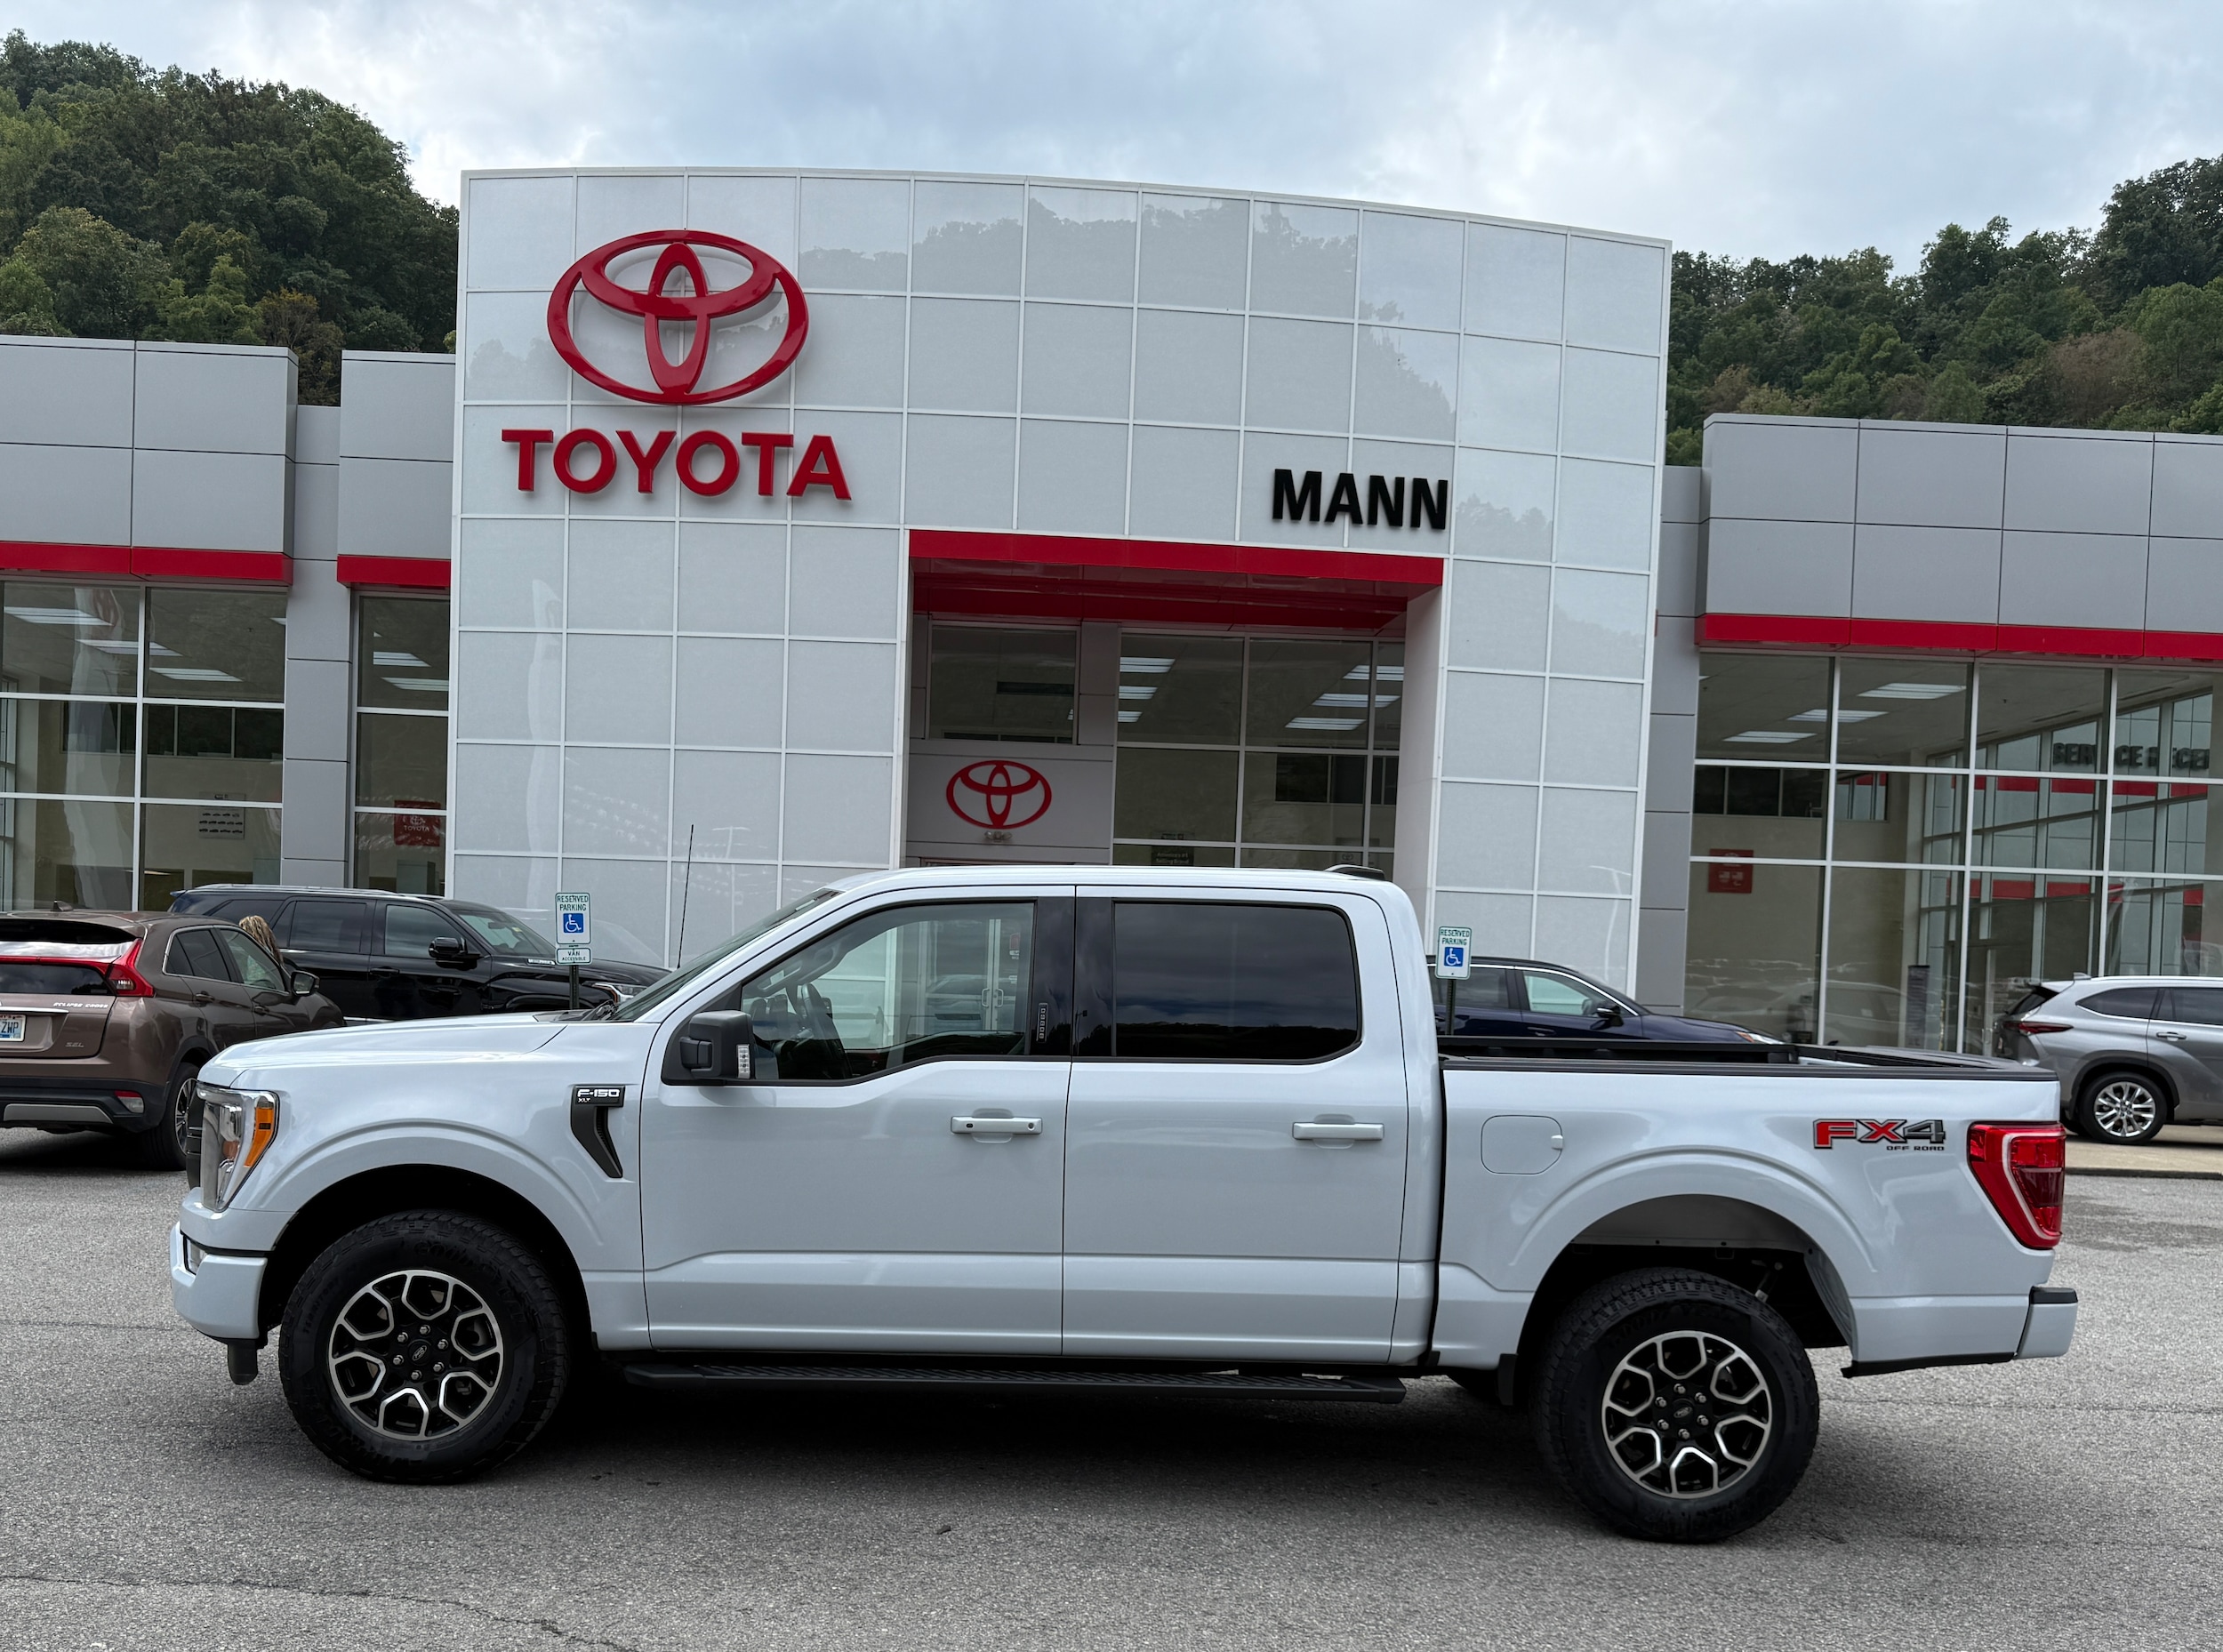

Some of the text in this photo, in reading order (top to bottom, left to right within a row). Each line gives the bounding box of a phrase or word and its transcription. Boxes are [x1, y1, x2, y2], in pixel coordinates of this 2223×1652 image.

[502, 428, 852, 501] TOYOTA
[1272, 469, 1449, 530] MANN
[559, 903, 587, 911] PARKING
[1441, 929, 1470, 937] RESERVED
[1441, 937, 1467, 945] PARKING
[577, 1088, 621, 1097] F-150
[1813, 1119, 1946, 1149] FX4
